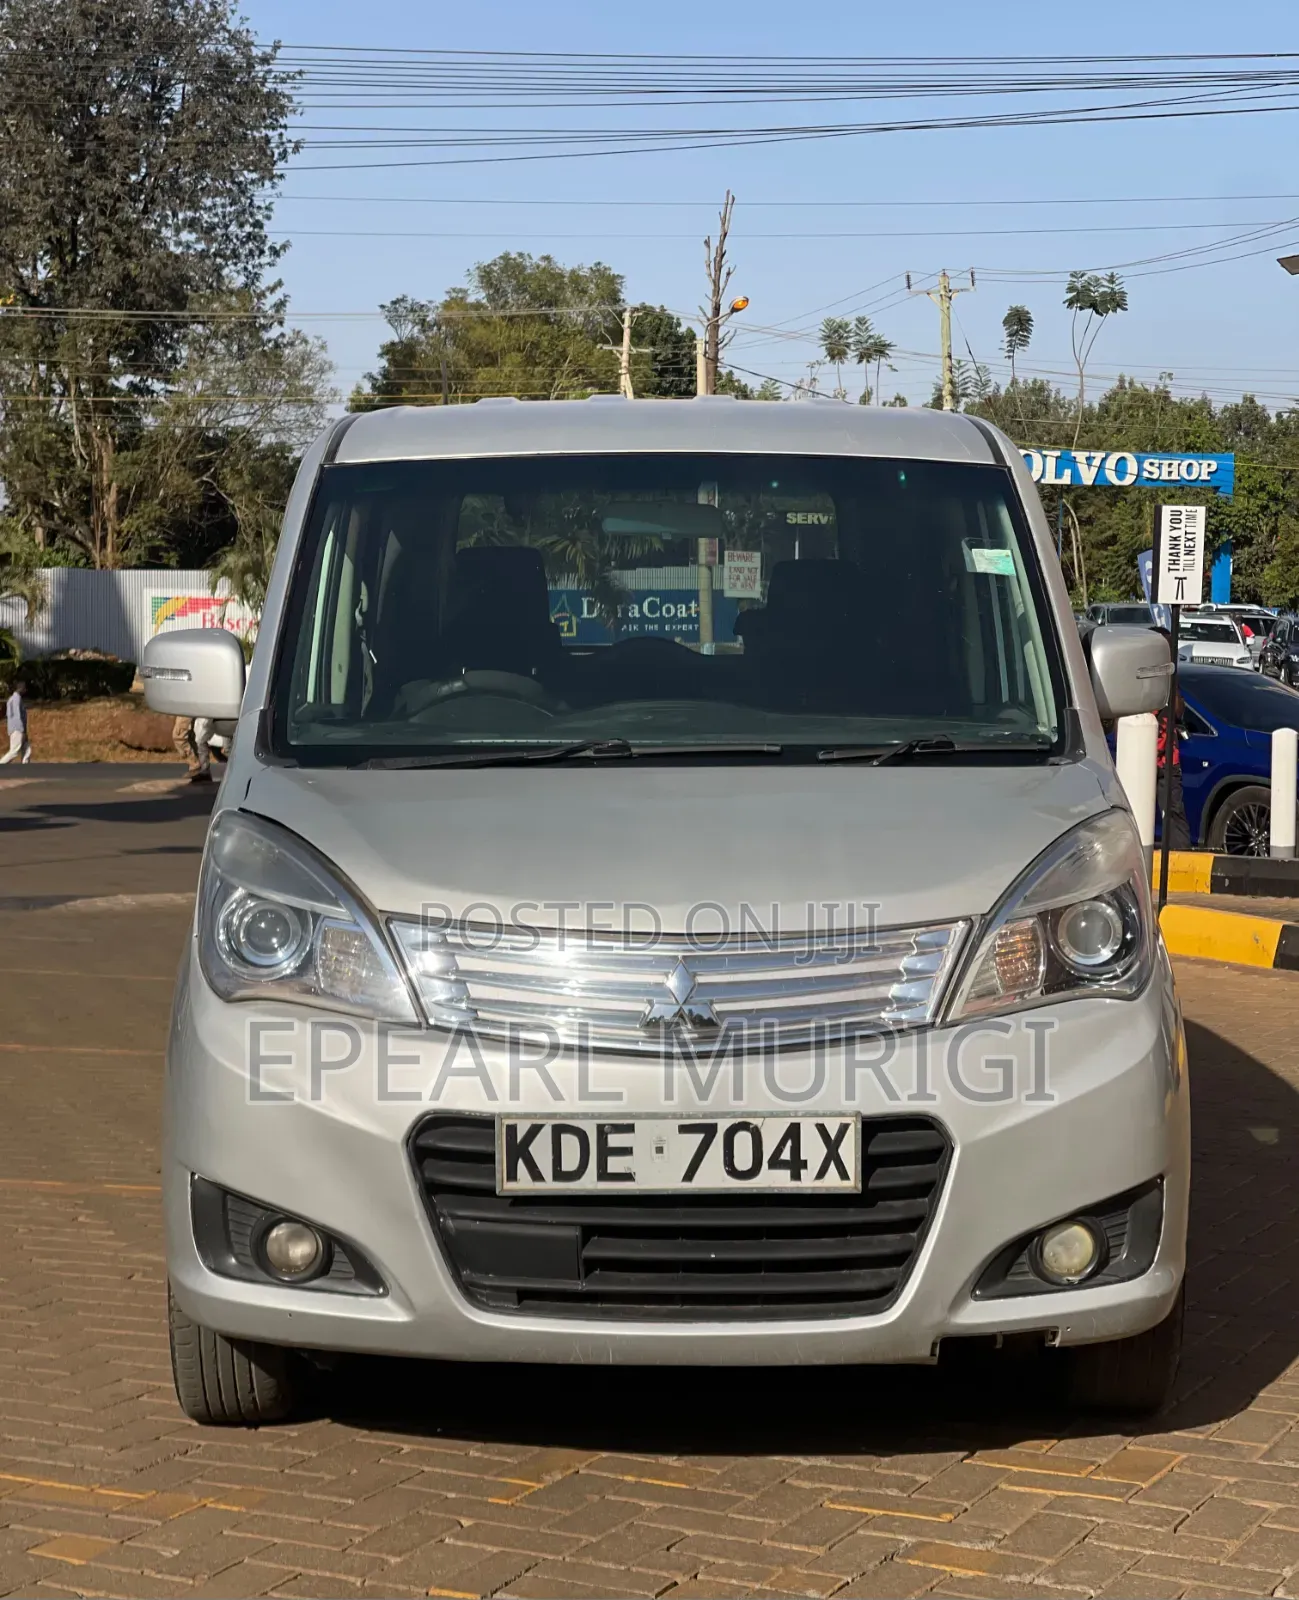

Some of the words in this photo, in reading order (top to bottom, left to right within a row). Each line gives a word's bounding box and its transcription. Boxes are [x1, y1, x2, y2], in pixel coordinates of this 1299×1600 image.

[1142, 458, 1218, 481] SHOP
[1169, 509, 1183, 532] YOU
[1185, 508, 1198, 529] TIME
[1168, 535, 1182, 574] THANK
[1183, 530, 1197, 557] NEXT
[728, 551, 755, 563] BEWARE
[1183, 558, 1196, 572] TILL
[581, 596, 698, 618] DraCoat
[621, 623, 639, 632] ASK
[644, 623, 659, 632] THE
[505, 1122, 636, 1183] KDE
[677, 1121, 852, 1183] 704X
